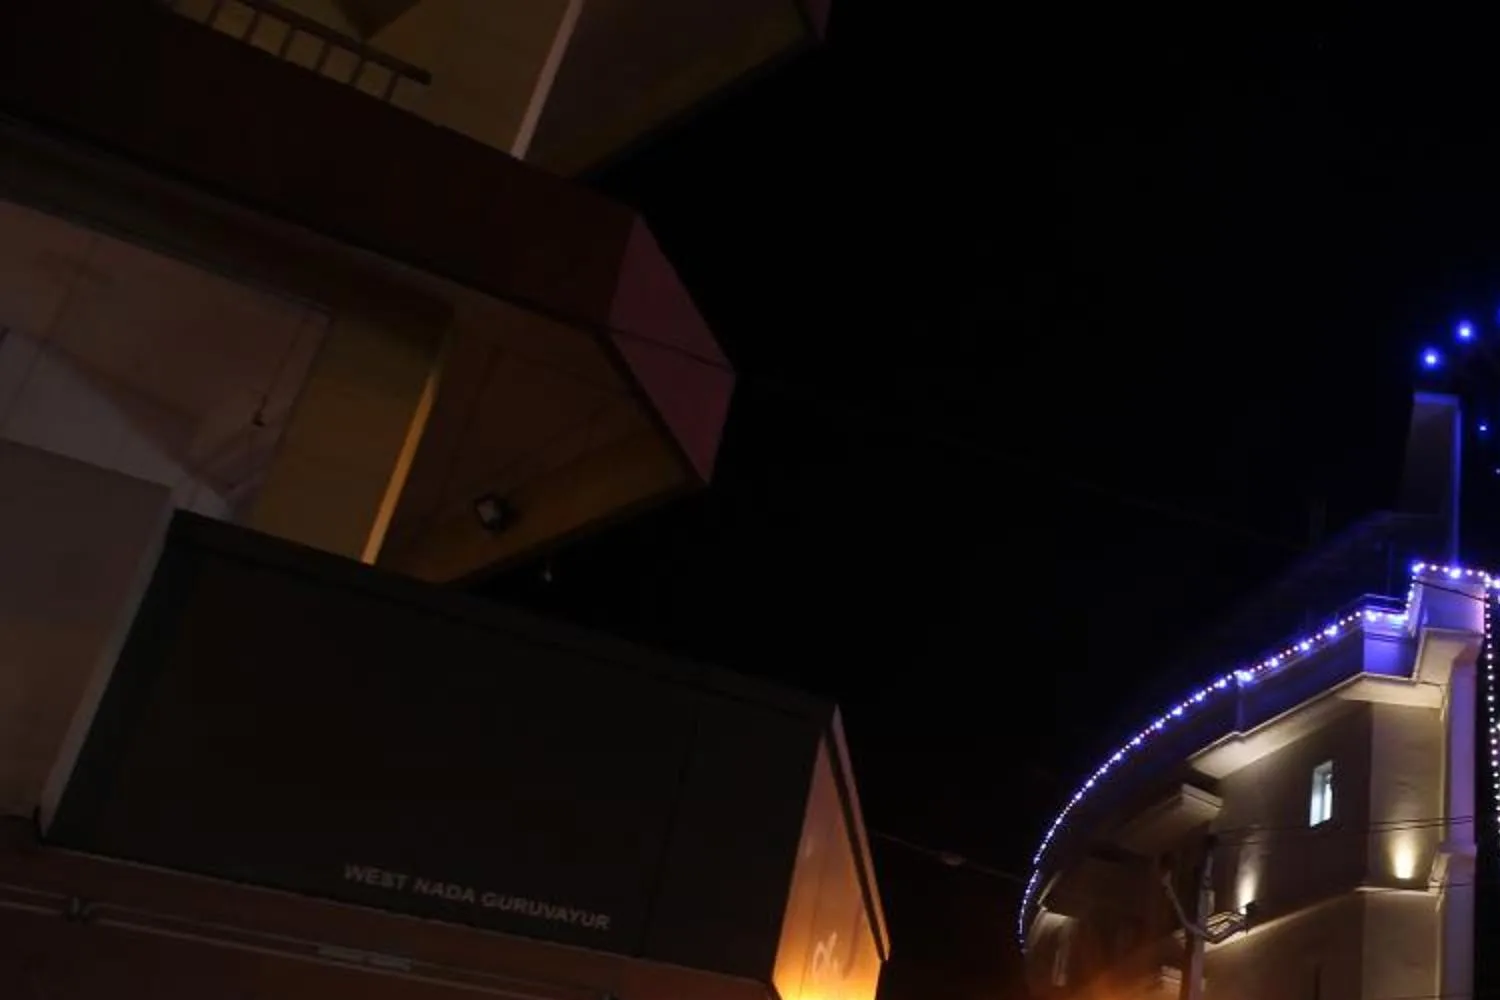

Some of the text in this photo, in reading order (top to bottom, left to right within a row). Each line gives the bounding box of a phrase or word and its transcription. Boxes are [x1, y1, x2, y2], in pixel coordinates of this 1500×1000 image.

[344, 864, 611, 931] WEST NADA GURUVAYUR
